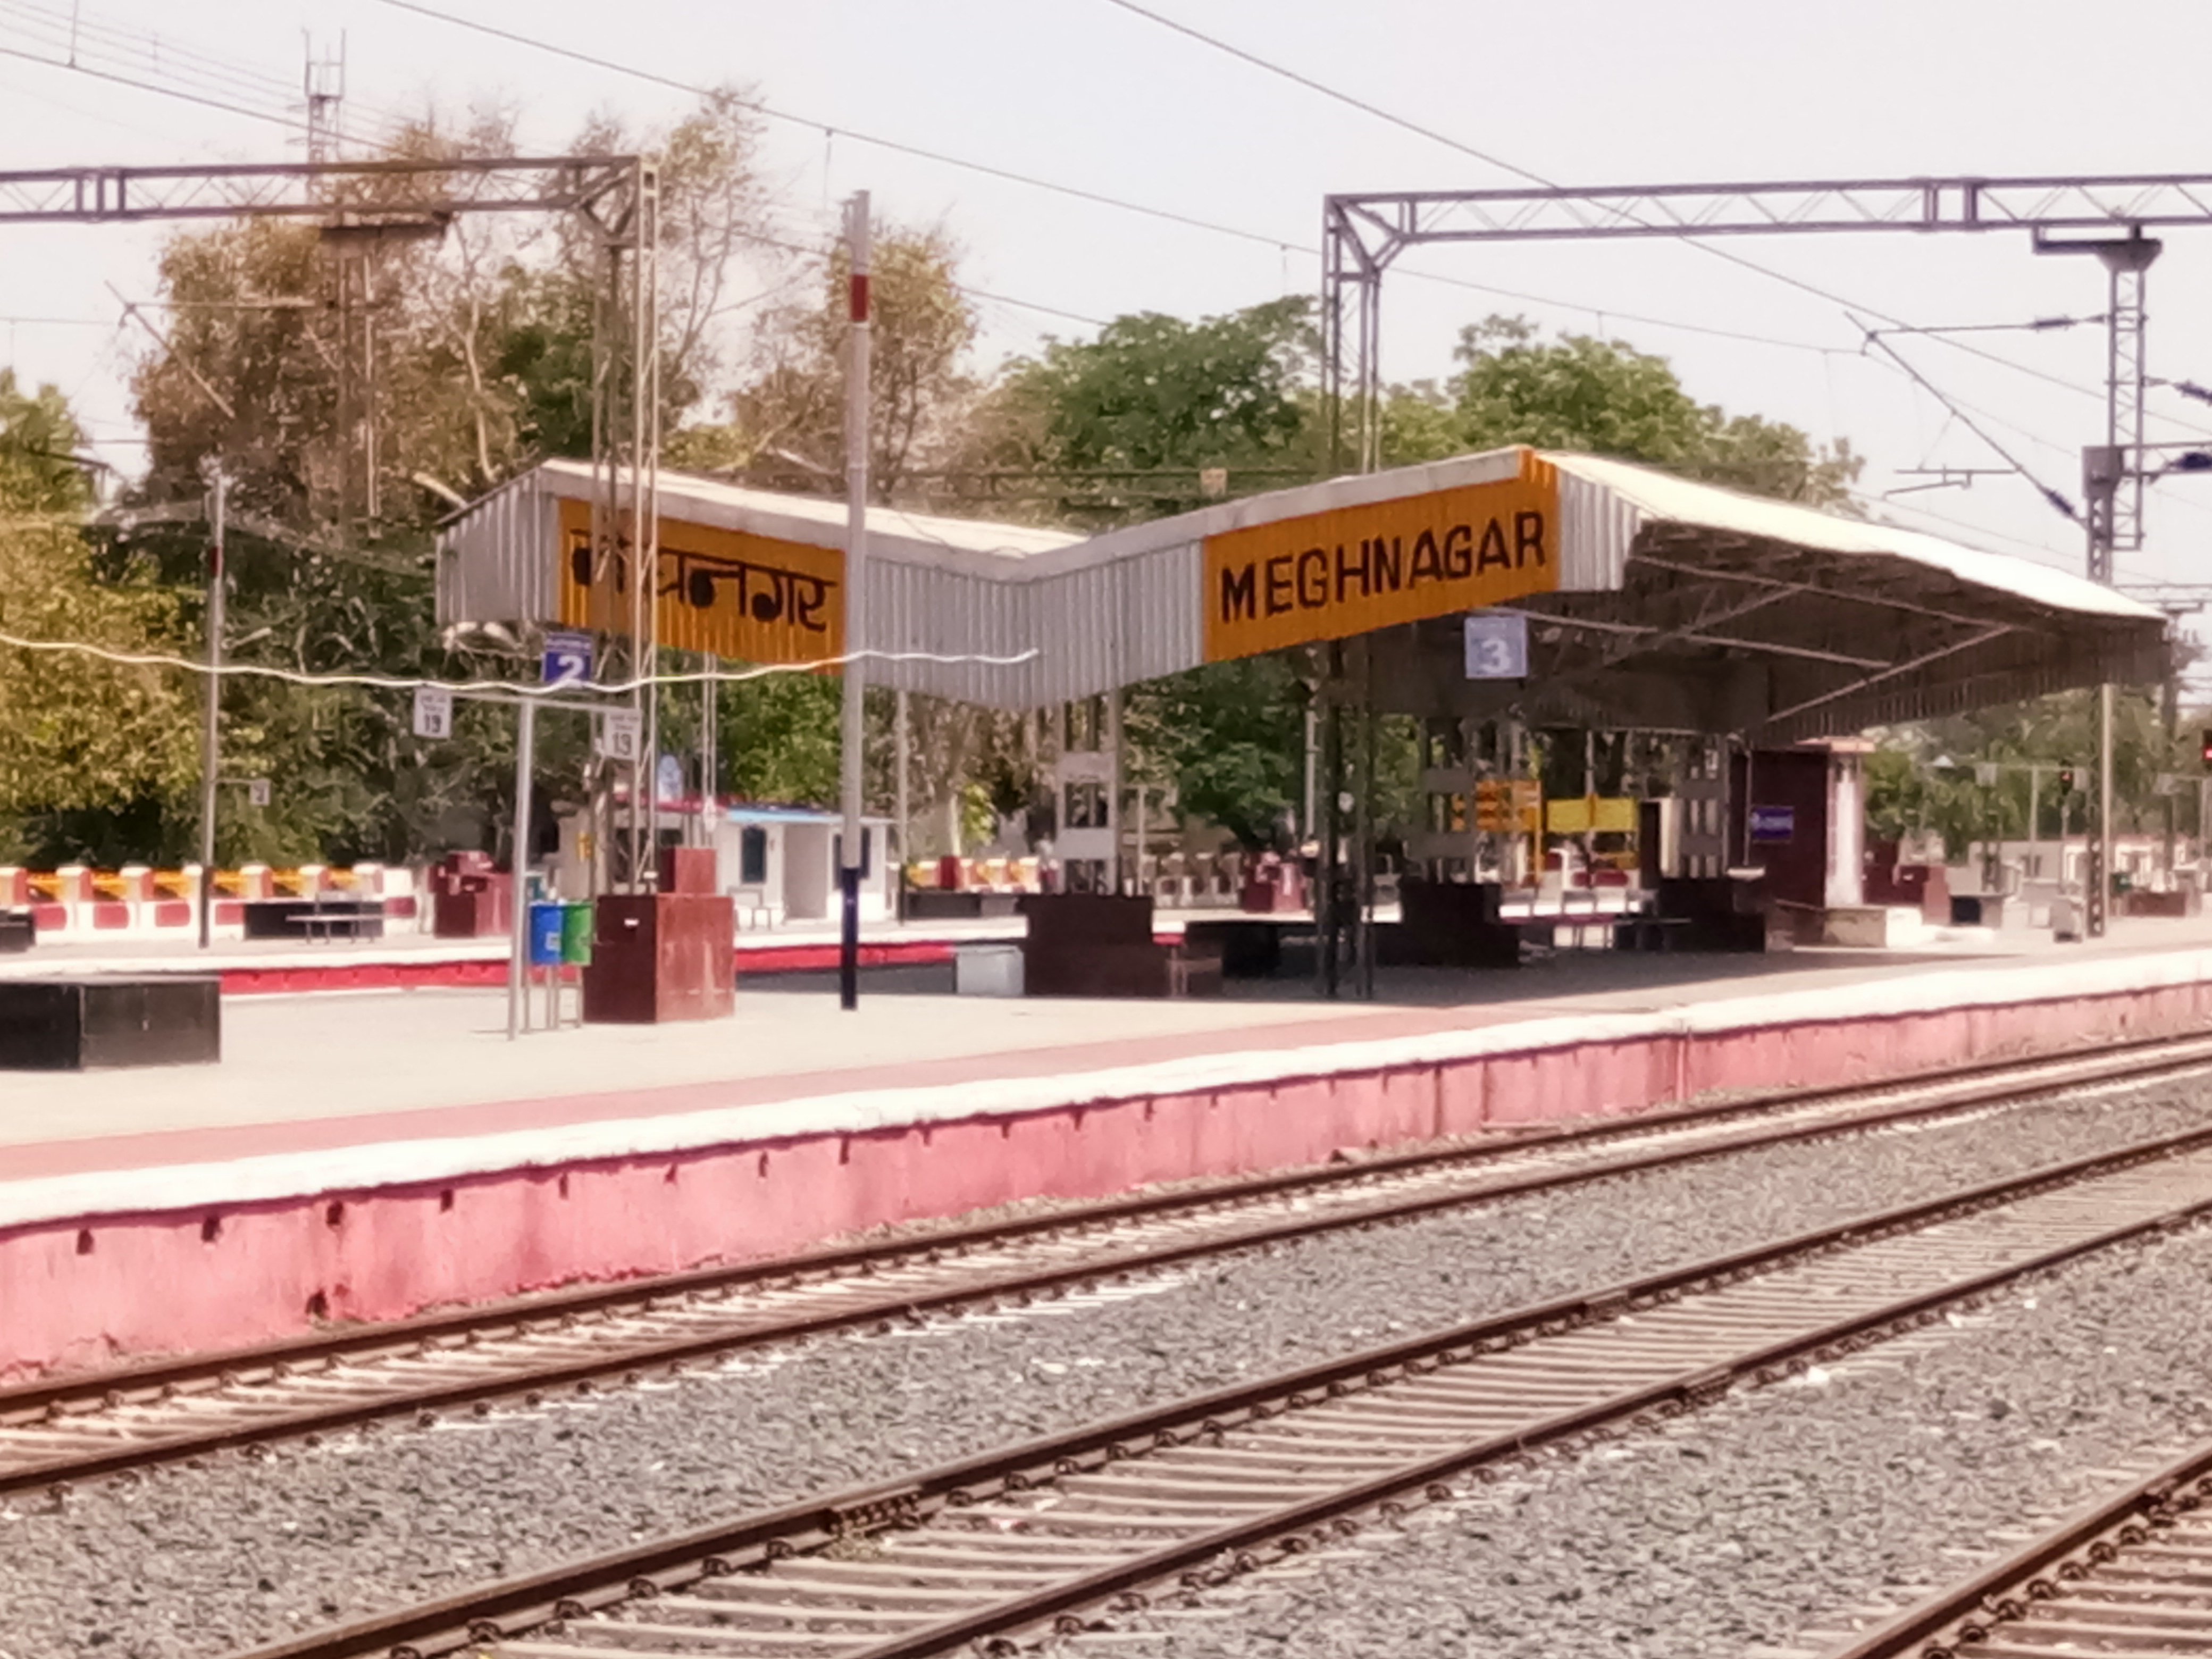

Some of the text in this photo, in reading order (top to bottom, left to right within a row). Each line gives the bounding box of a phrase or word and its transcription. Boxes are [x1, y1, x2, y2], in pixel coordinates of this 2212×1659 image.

[1221, 510, 1546, 624] MEGHNAGAR
[556, 655, 585, 687] 2
[1480, 638, 1512, 674] 3
